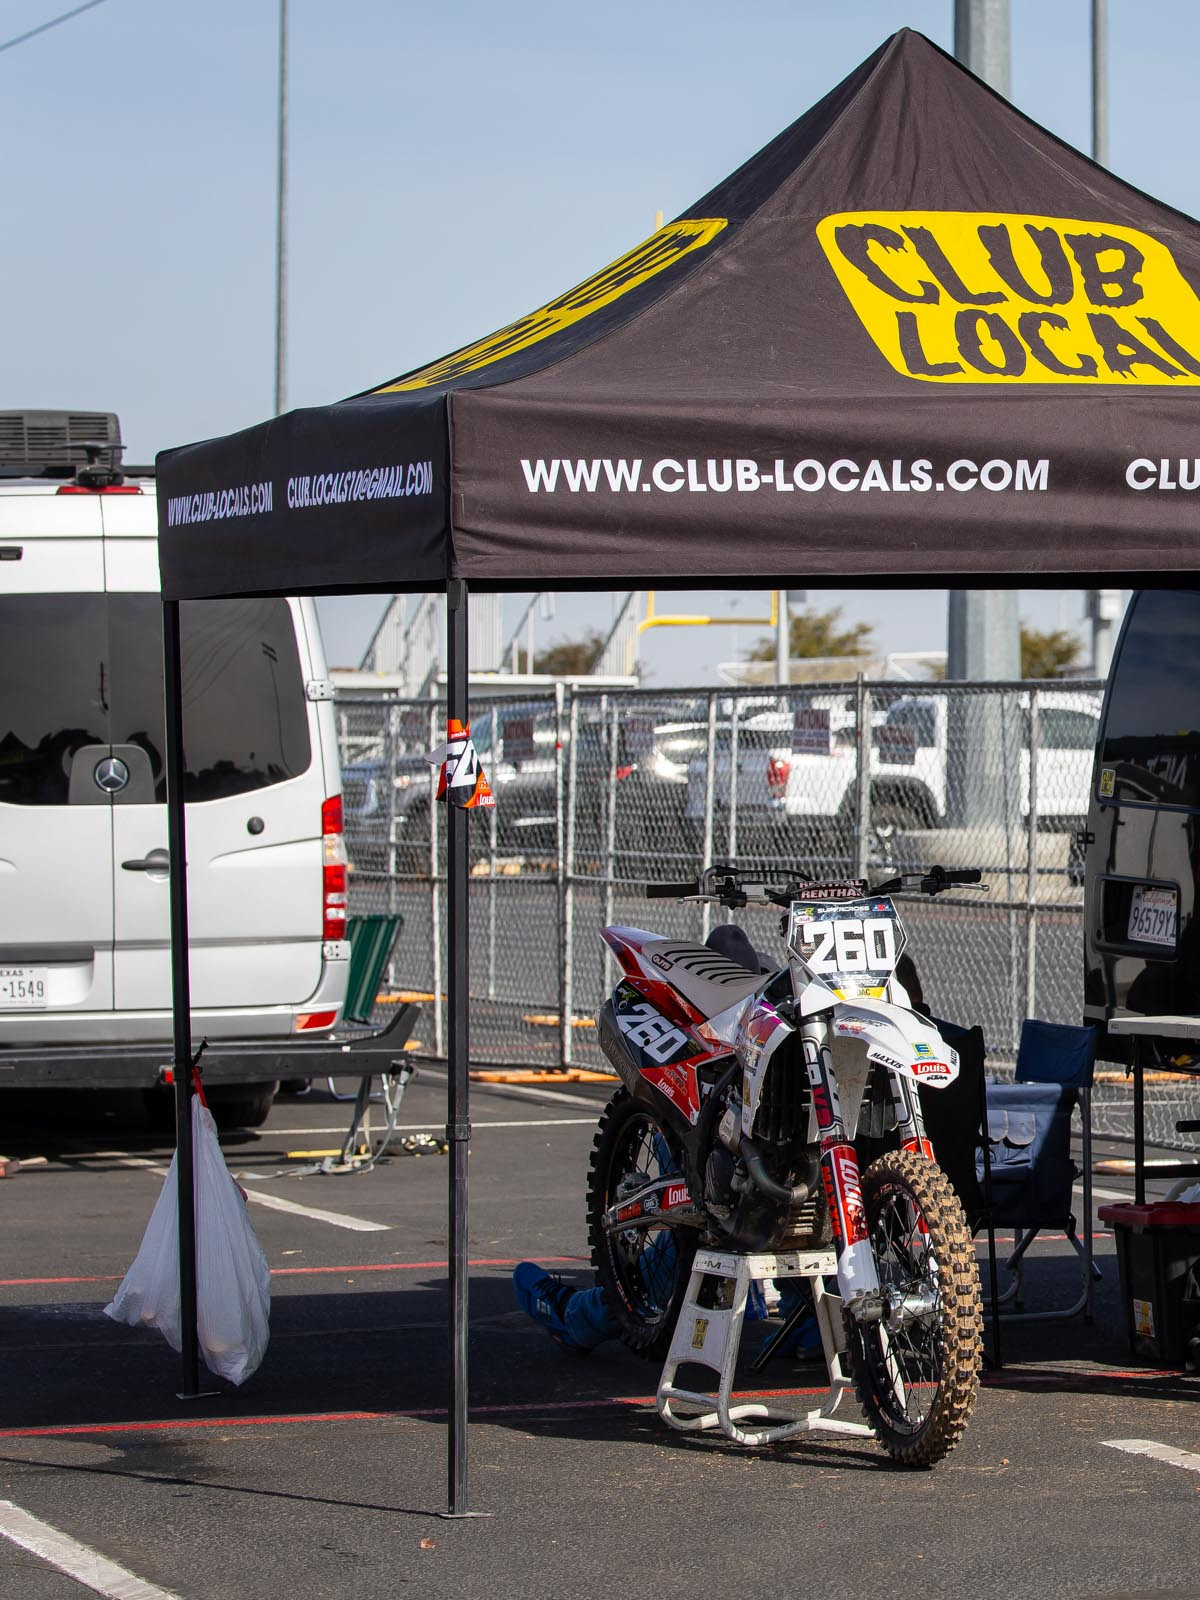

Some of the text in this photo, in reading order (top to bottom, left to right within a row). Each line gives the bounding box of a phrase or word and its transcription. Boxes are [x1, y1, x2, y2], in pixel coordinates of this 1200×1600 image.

[834, 223, 1145, 308] CLUB
[168, 461, 433, 527] WWW.CLUB-LOCALS.COM CLUB.LOCALS10@GMAIL.COM
[520, 458, 1050, 493] WWW.CLUB-LOCALS.COM
[803, 918, 896, 975] 260
[617, 1003, 688, 1063] 260
[870, 1052, 904, 1069] MAXXIS
[917, 1062, 947, 1074] Louis
[657, 1077, 675, 1098] Louis
